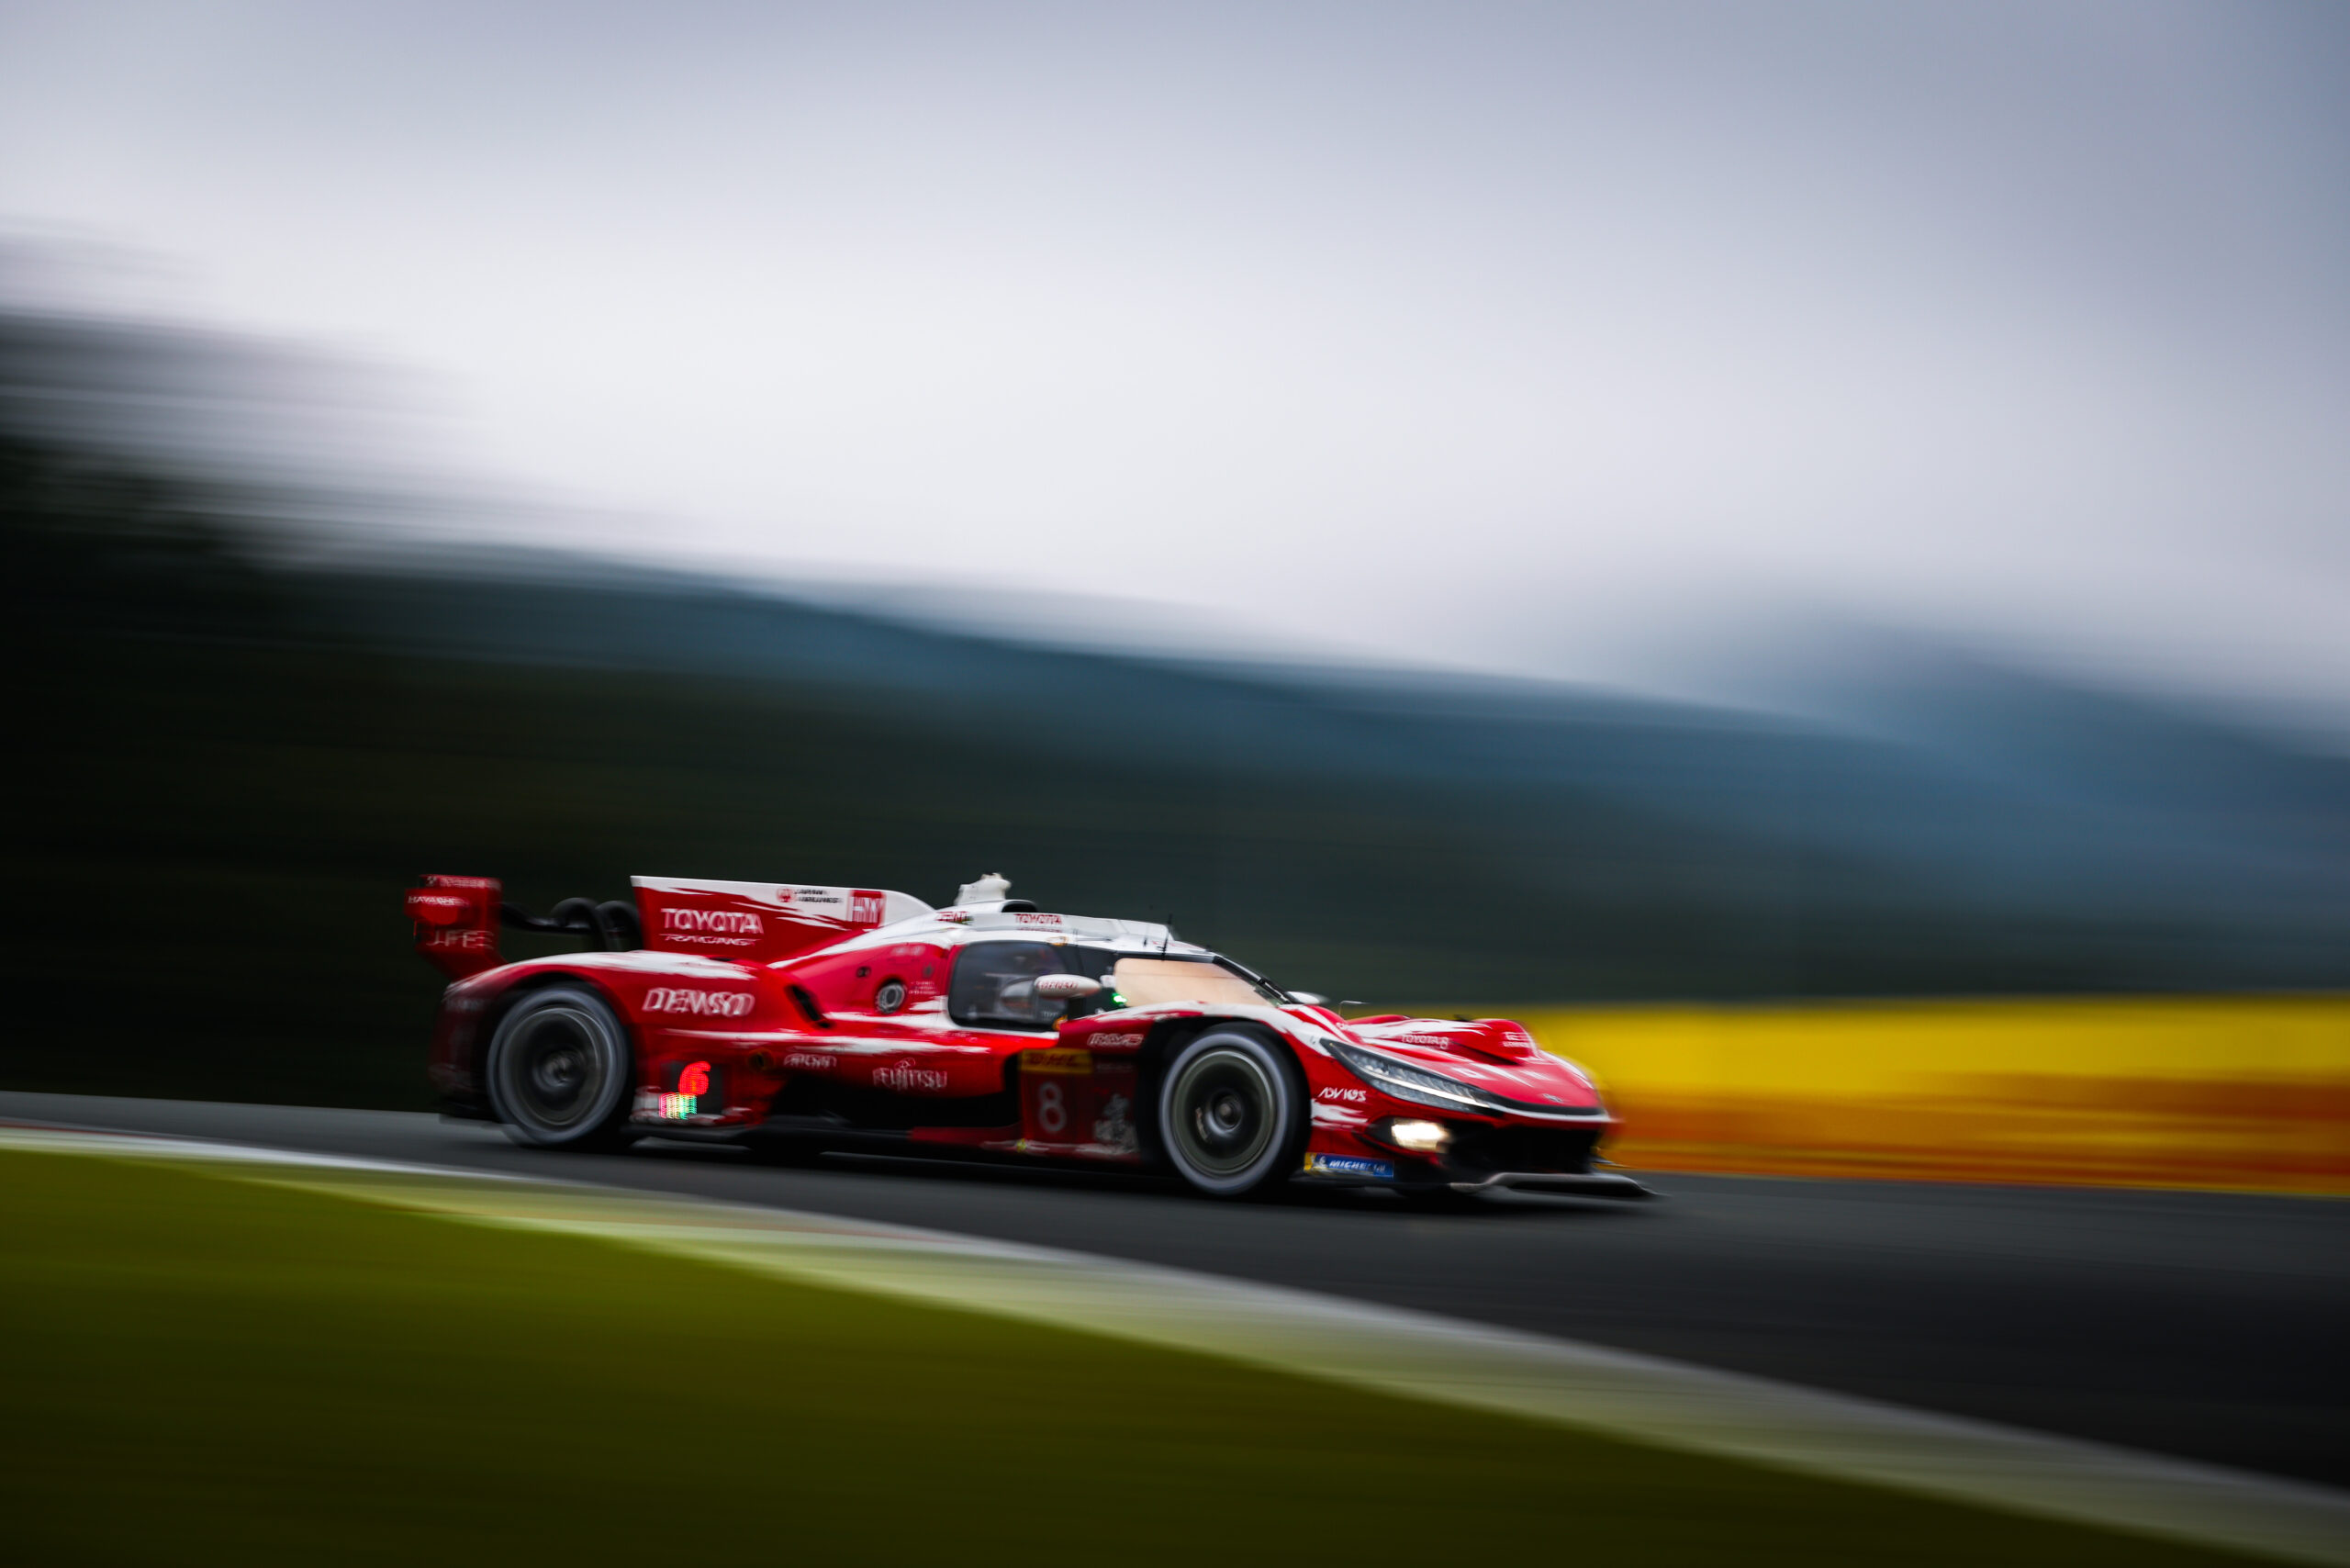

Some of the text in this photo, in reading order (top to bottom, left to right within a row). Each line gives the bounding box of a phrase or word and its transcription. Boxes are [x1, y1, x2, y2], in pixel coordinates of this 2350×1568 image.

[660, 908, 764, 935] TOYOTA
[1013, 913, 1062, 924] TOYOTA
[642, 988, 755, 1018] DENSO
[1401, 1035, 1439, 1045] TOYOTA
[678, 1060, 711, 1096] 6
[872, 1067, 948, 1092] FUJITSU
[1038, 1081, 1067, 1135] 8
[1329, 1159, 1386, 1171] MICHELIN
